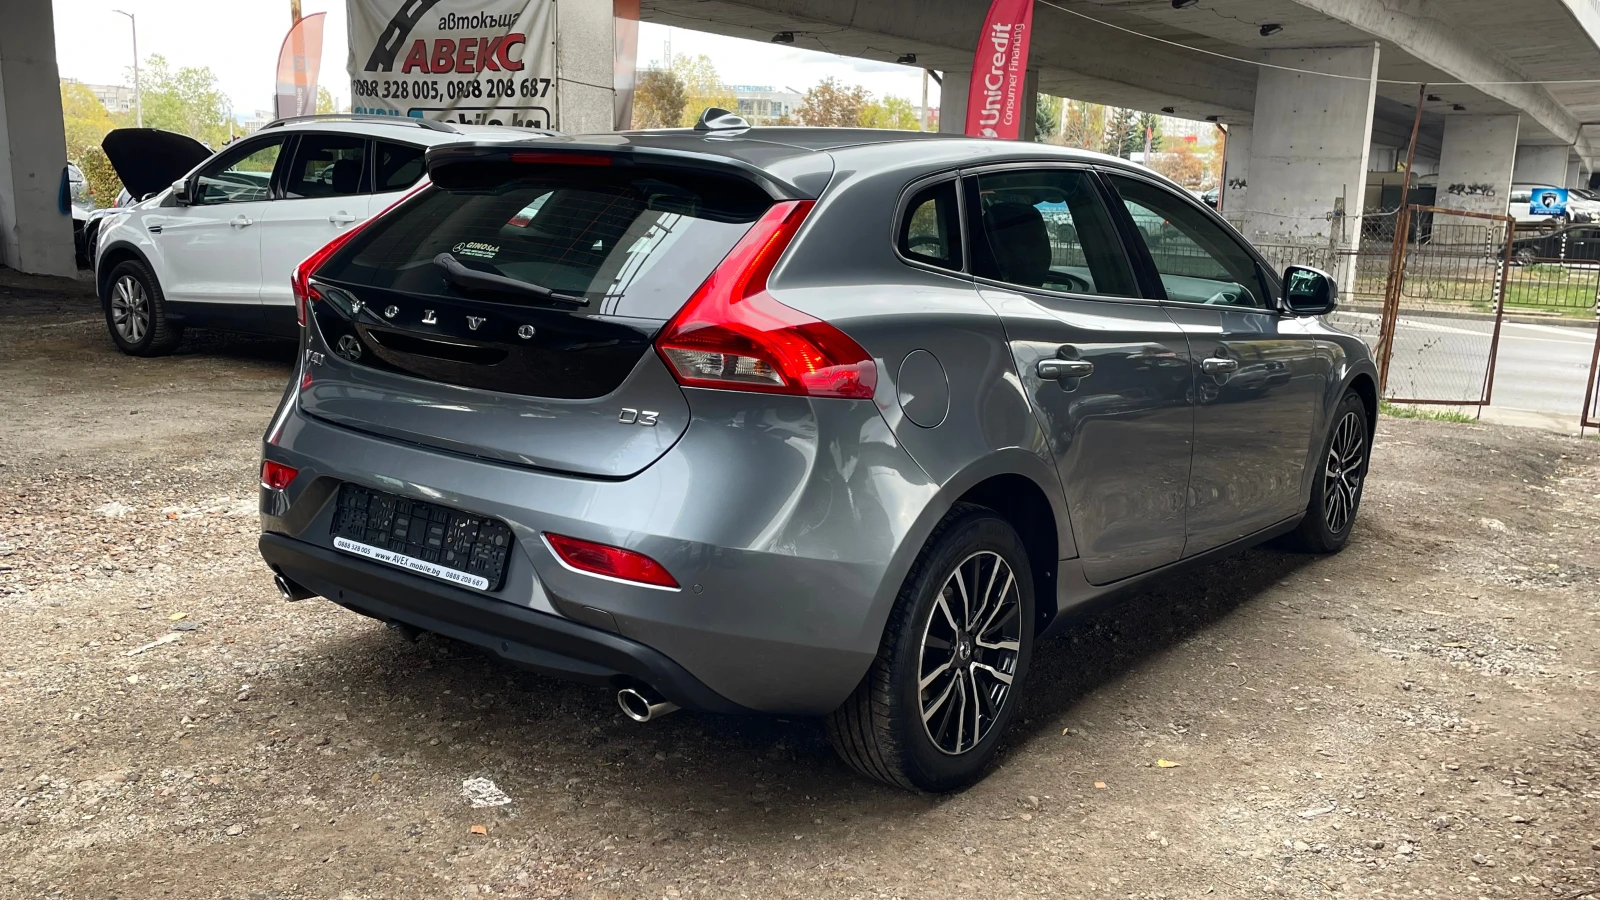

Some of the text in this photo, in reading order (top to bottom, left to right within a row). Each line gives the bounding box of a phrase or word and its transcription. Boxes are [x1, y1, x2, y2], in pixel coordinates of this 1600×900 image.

[438, 11, 520, 30] автокъща
[401, 33, 526, 74] АВЕКС
[979, 22, 1012, 125] UniCredit
[382, 80, 409, 99] 328
[412, 80, 444, 103] 005,
[447, 79, 482, 99] 0888
[486, 78, 515, 98] 208
[520, 78, 551, 98] 687
[1003, 23, 1025, 125] Consumer Financing
[350, 300, 536, 340] VOLVO
[618, 407, 660, 426] D3
[337, 540, 351, 549] 0888
[351, 544, 361, 552] 328
[360, 547, 371, 555] 005
[445, 571, 460, 581] 0888
[460, 575, 472, 584] 208
[471, 578, 483, 587] 687
